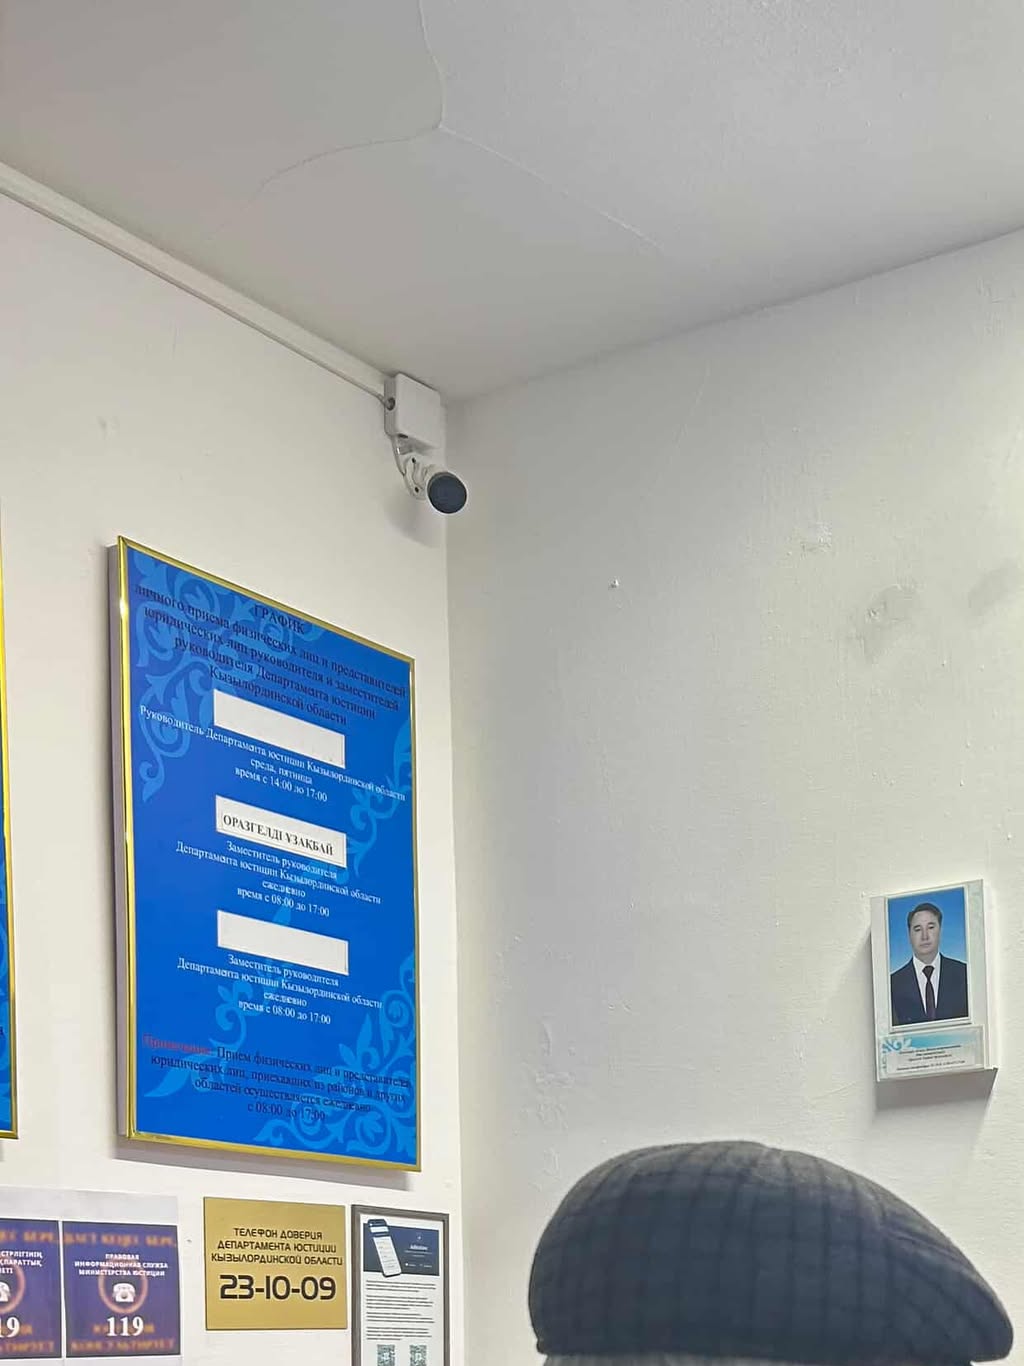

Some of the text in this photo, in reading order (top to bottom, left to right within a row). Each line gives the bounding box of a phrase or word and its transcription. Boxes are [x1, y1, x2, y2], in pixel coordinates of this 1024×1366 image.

[134, 583, 185, 614] личного
[144, 606, 223, 645] юридических
[253, 602, 305, 635] ГРАФИК
[174, 637, 253, 673] руководителя
[209, 664, 347, 727] Кызылординской области
[140, 704, 204, 735] Руководитель
[206, 727, 267, 757] Департамента
[270, 775, 293, 792] 14:00
[306, 787, 328, 803] 17:00
[176, 840, 238, 867] Департамента
[226, 840, 280, 864] Заместитель
[271, 893, 295, 909] 08:00
[308, 902, 330, 918] 17:00
[177, 957, 239, 980] Департамента
[228, 953, 282, 975] Заместитель
[272, 1004, 296, 1018] 08:00
[310, 1011, 331, 1025] 17:00
[234, 1227, 323, 1240] ТЕЛЕФОН ДОВЕРИЯ
[217, 1240, 337, 1254] ДЕПАРТАМЕНТА ЮСТИЦИИ
[304, 1256, 343, 1266] ОБЛАСТИ
[220, 1274, 337, 1300] 23-10-09
[106, 1315, 145, 1337] 119
